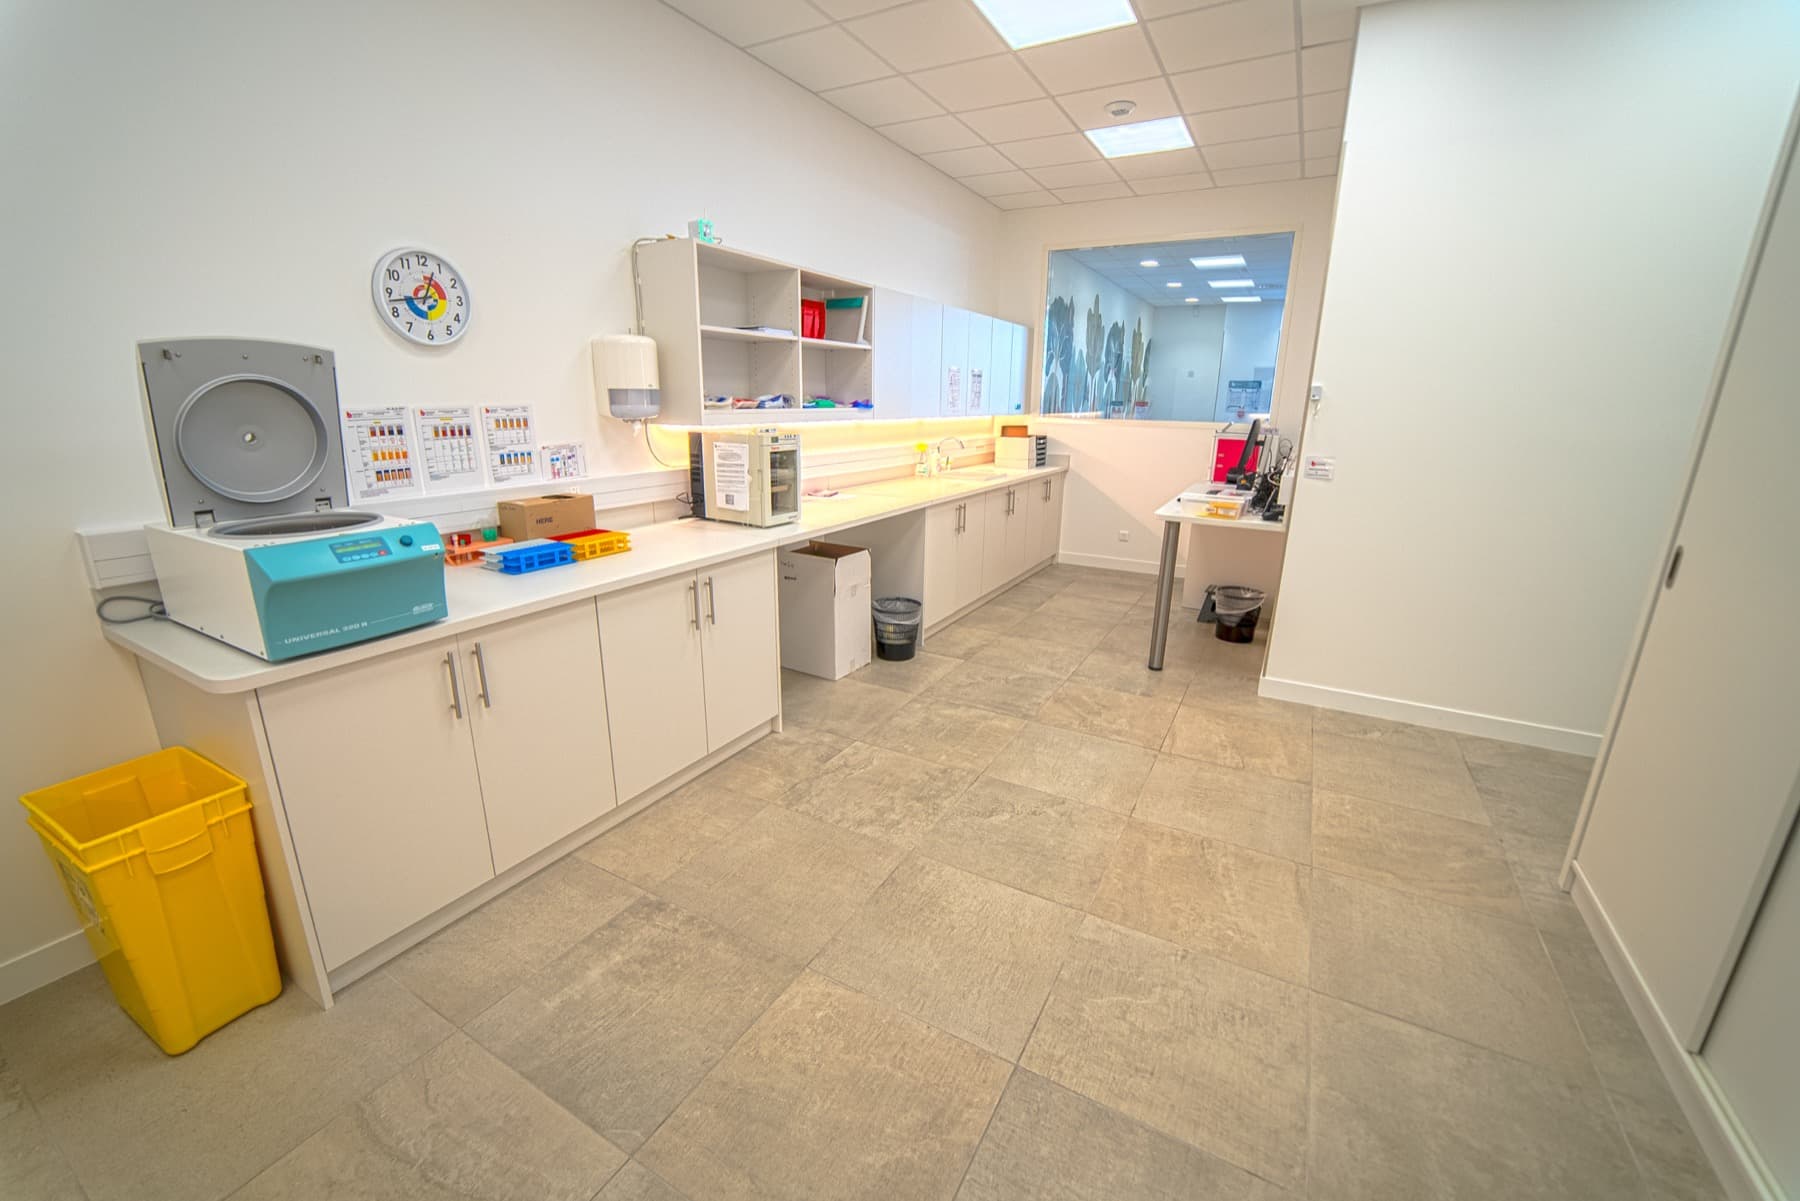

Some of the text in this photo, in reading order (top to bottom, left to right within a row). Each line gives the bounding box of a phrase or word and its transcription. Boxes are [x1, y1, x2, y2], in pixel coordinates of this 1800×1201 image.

[400, 257, 410, 270] 11
[416, 255, 428, 267] 12
[437, 263, 441, 274] 1
[386, 268, 400, 281] 10
[450, 278, 457, 289] 2
[386, 287, 392, 298] 9
[456, 296, 463, 307] 3
[392, 307, 400, 318] 8
[454, 314, 461, 323] 4
[406, 321, 413, 333] 7
[446, 325, 453, 336] 5
[427, 330, 434, 340] 6
[284, 628, 341, 644] UNIVERSAL
